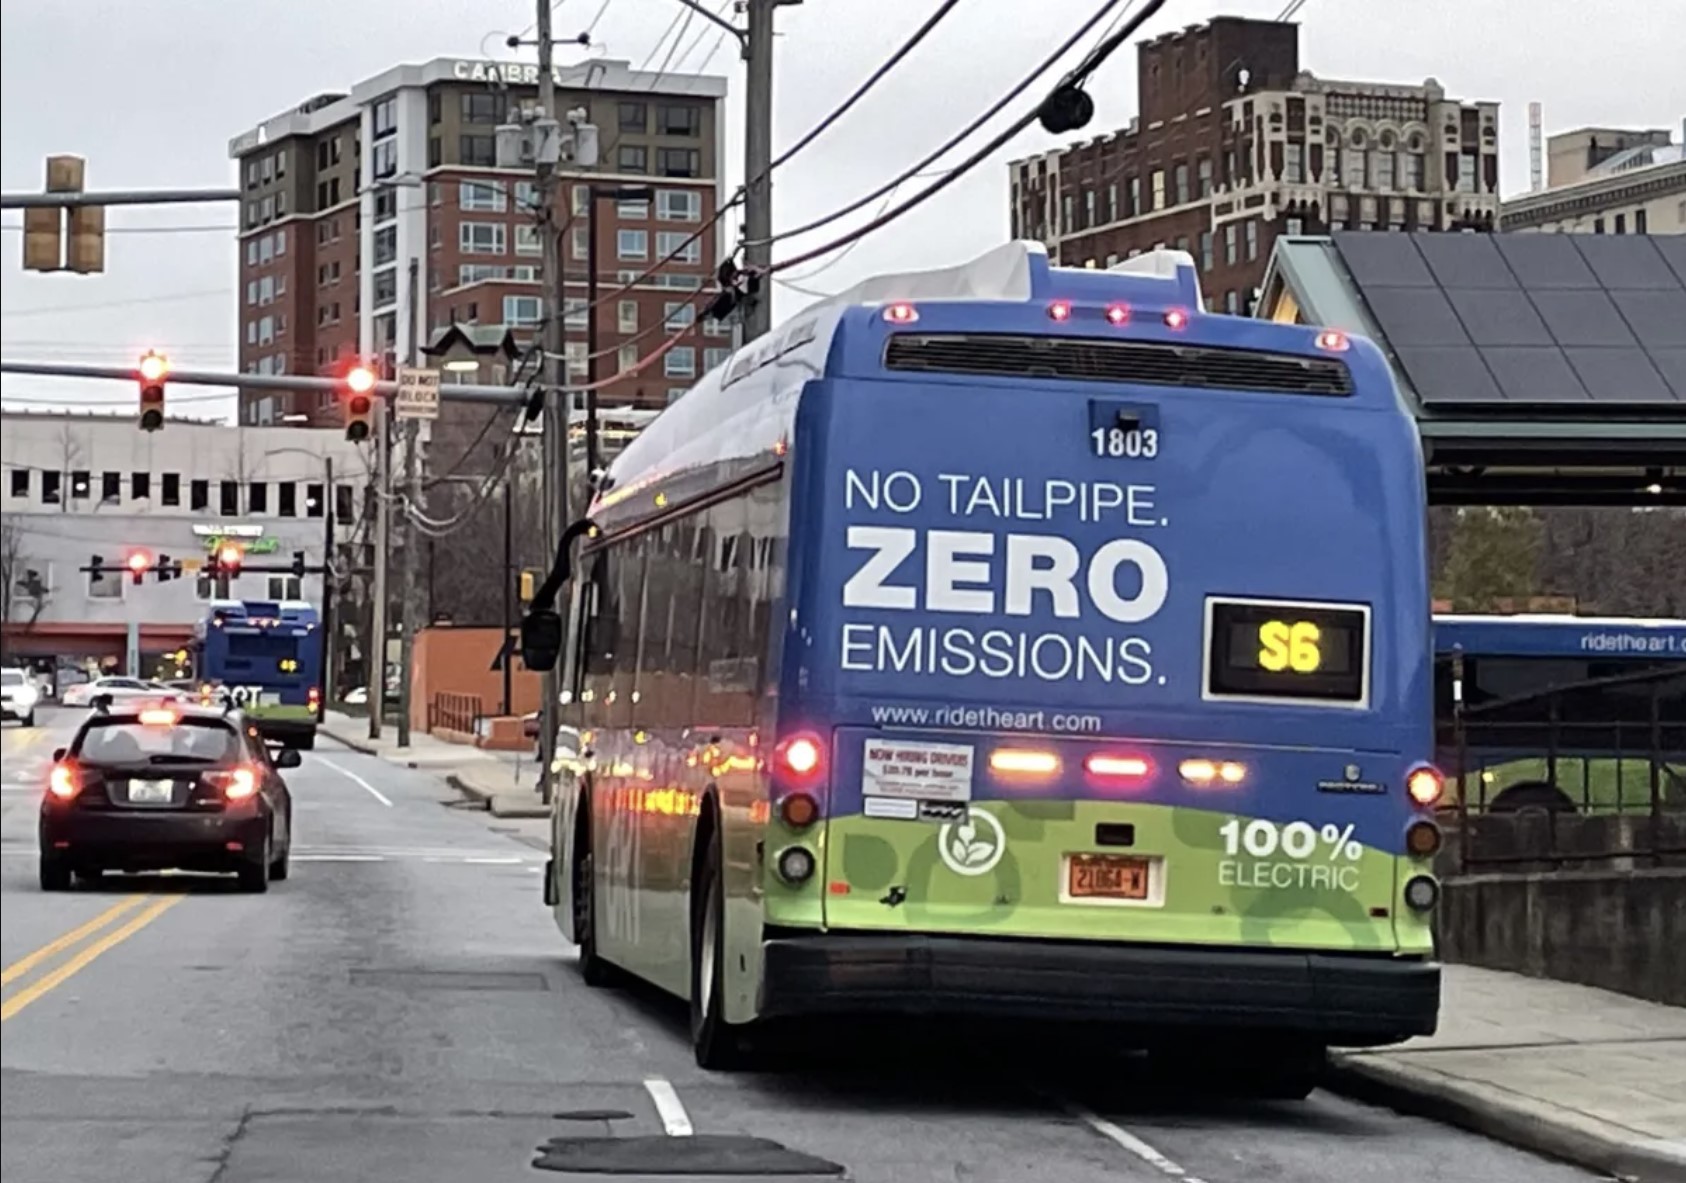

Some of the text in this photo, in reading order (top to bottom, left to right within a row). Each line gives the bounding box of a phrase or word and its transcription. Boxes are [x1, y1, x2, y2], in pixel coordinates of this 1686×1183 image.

[454, 61, 561, 84] CAMBRA
[400, 390, 437, 402] BLOCK
[401, 375, 439, 387] DO NOT
[1091, 427, 1159, 458] 1803
[845, 468, 1169, 527] NO TAILPIPE.
[843, 525, 1170, 624] ZERO
[841, 623, 1167, 686] EMISSIONS.
[1258, 620, 1321, 673] S6
[871, 706, 1102, 732] www.ridetheart.com
[869, 748, 969, 767] NOW HIRING DRIVERS
[1219, 818, 1364, 862] 100%
[1218, 860, 1361, 892] ELECTRIC
